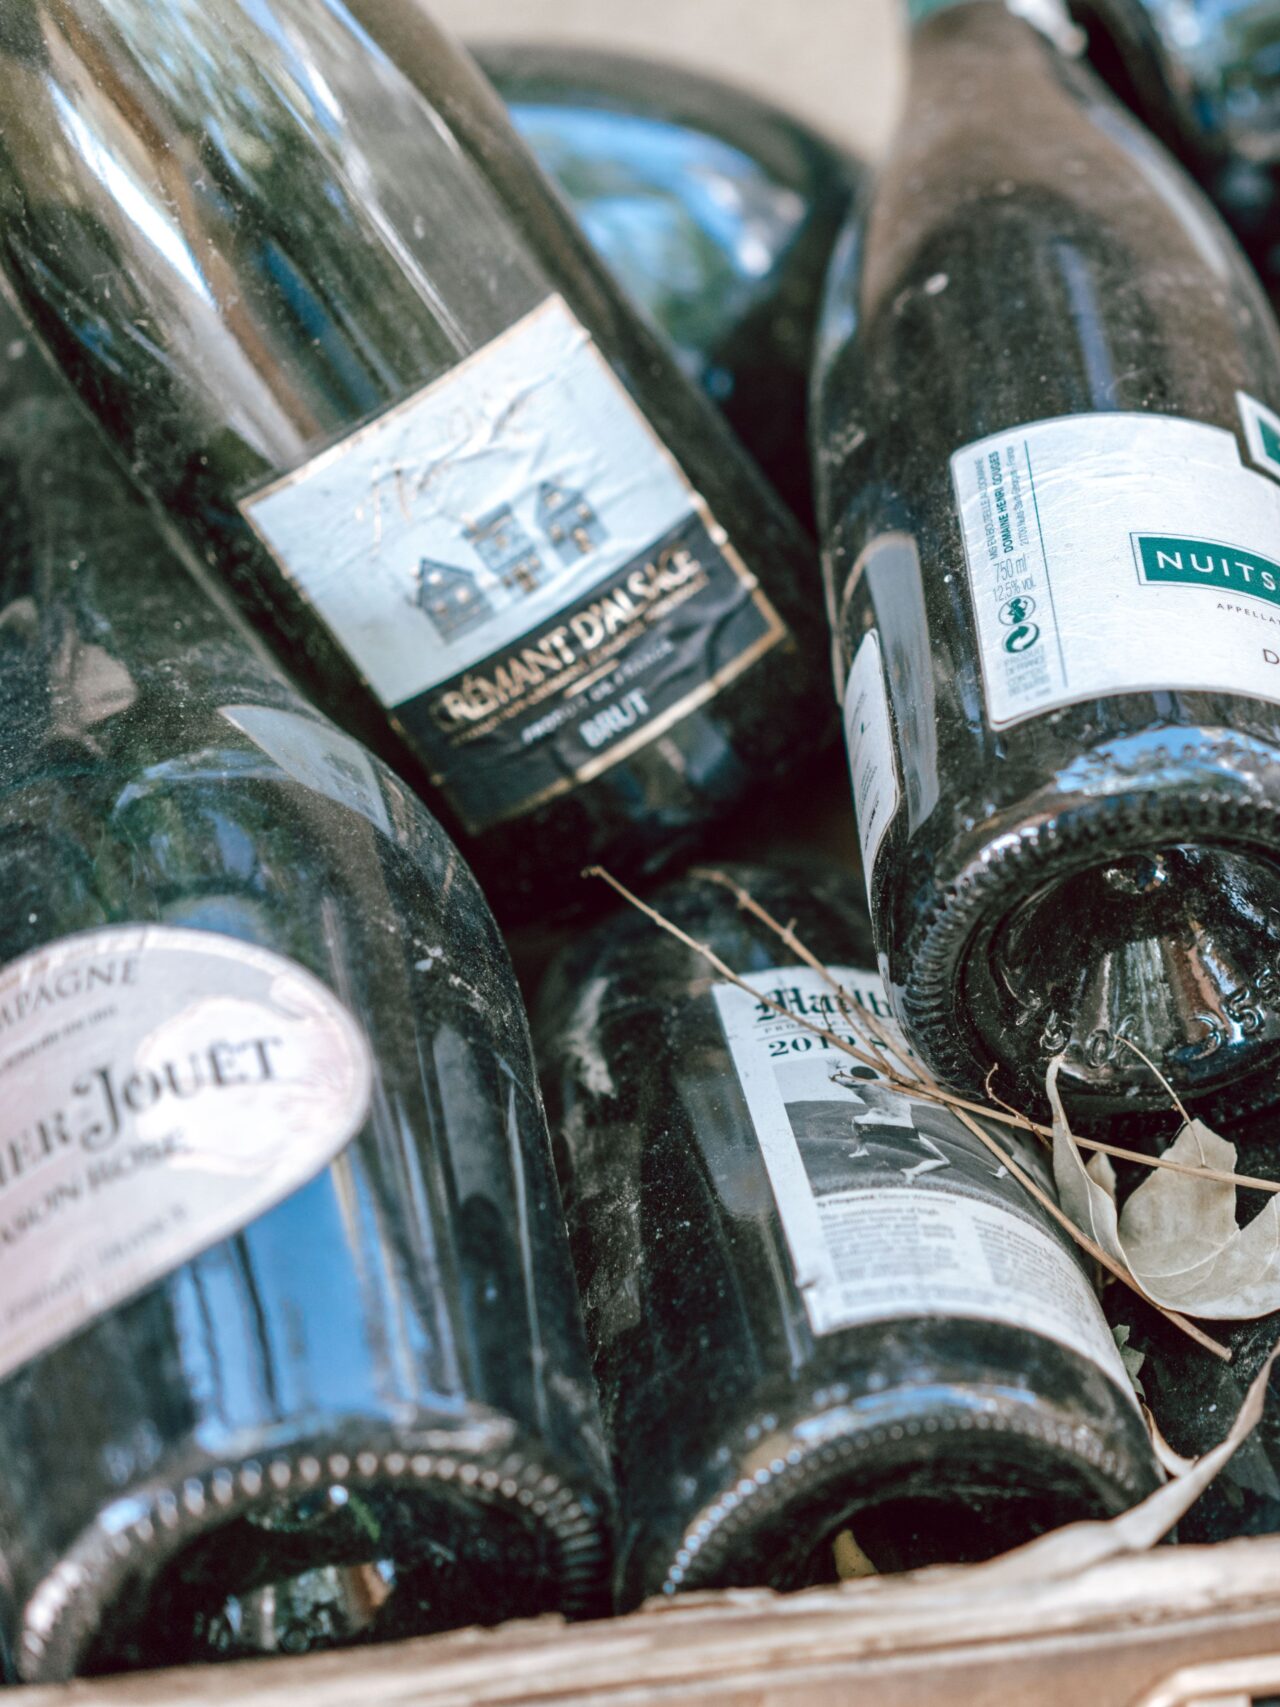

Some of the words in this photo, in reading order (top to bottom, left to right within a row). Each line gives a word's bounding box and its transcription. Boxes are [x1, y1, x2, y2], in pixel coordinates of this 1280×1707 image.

[988, 451, 1002, 486] GOUGES
[995, 487, 1008, 513] HENRI
[999, 513, 1014, 554] DOMAINE
[994, 559, 1013, 583] 750
[1016, 553, 1027, 573] ml
[579, 687, 650, 748] BRUT
